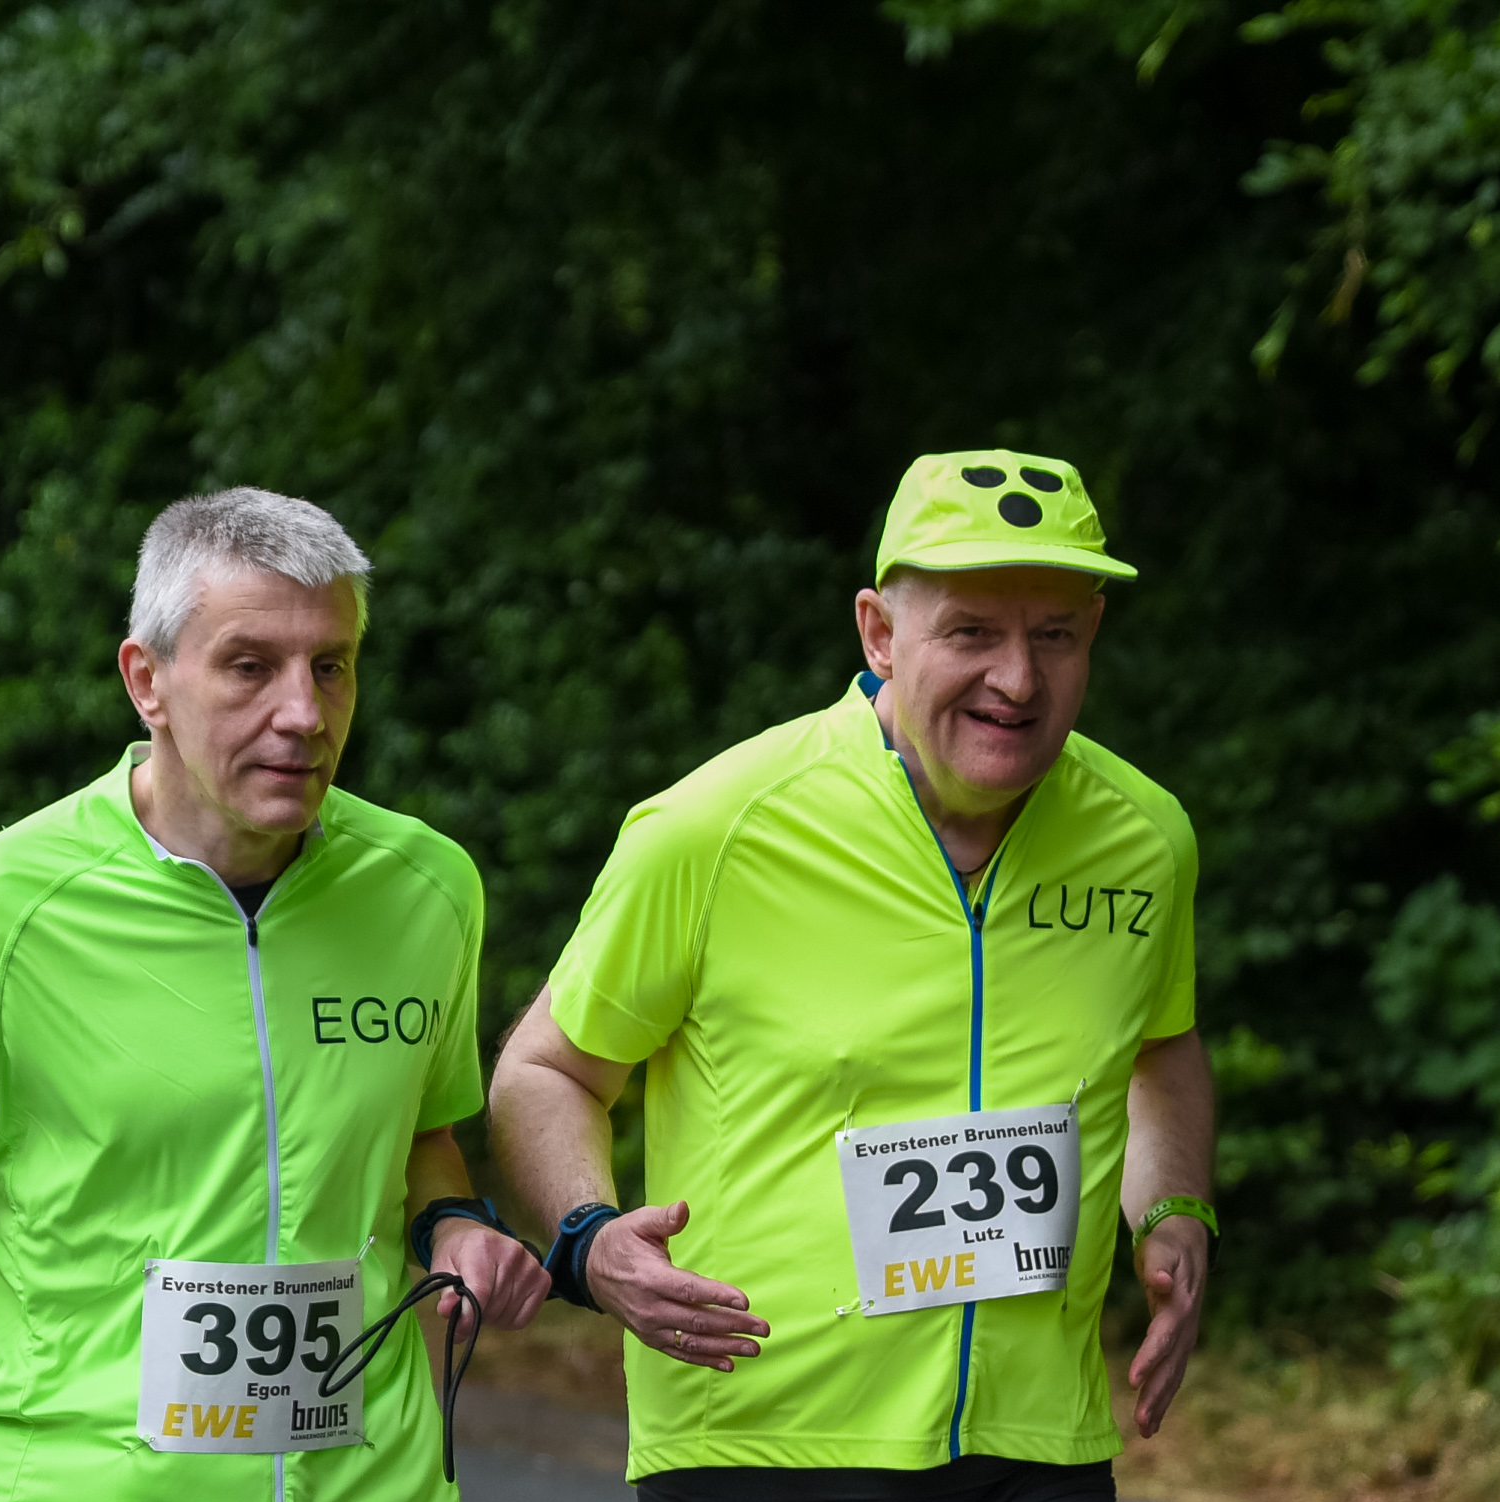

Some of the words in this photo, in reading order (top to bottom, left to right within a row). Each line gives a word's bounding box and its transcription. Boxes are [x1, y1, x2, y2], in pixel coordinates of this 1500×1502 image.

[1029, 883, 1154, 937] LUTZ
[854, 1133, 959, 1158] Everstener
[963, 1119, 1069, 1143] Brunnenlauf
[883, 1144, 1059, 1234] 239
[962, 1227, 1005, 1244] Lutz
[161, 1277, 268, 1296] Everstener
[273, 1274, 355, 1295] Brunnenlauf
[884, 1252, 976, 1297] EWE
[179, 1300, 342, 1376] 395
[246, 1383, 291, 1400] Egon
[161, 1402, 258, 1438] EWE
[290, 1400, 348, 1431] bruns
